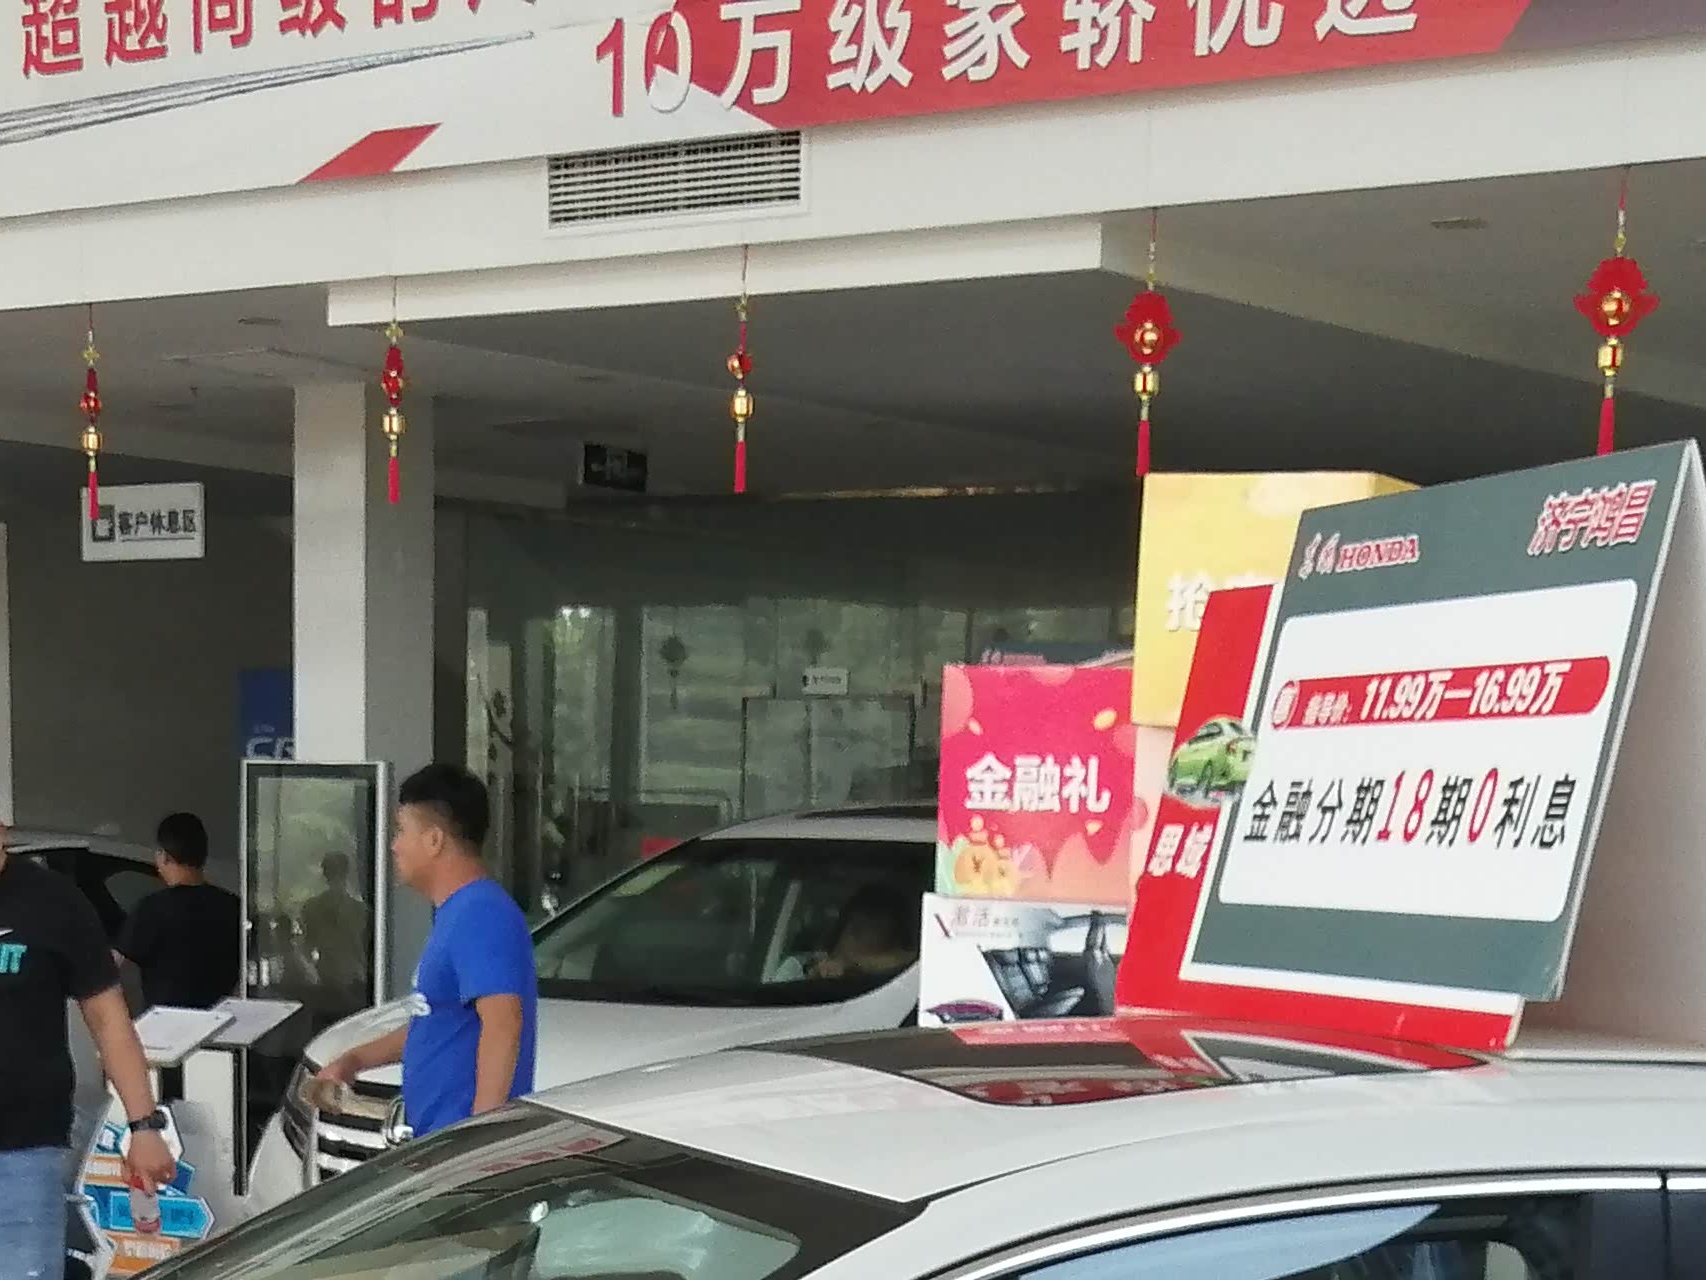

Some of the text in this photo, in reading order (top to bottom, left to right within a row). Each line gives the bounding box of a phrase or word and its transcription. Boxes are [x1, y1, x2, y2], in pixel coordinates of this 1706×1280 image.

[1527, 480, 1657, 559] 济宁鸿昌
[1335, 534, 1421, 573] HONDA
[964, 754, 1112, 814] 金融礼
[1243, 767, 1578, 849] 金融分期18期0利息
[1147, 820, 1217, 879] 思域
